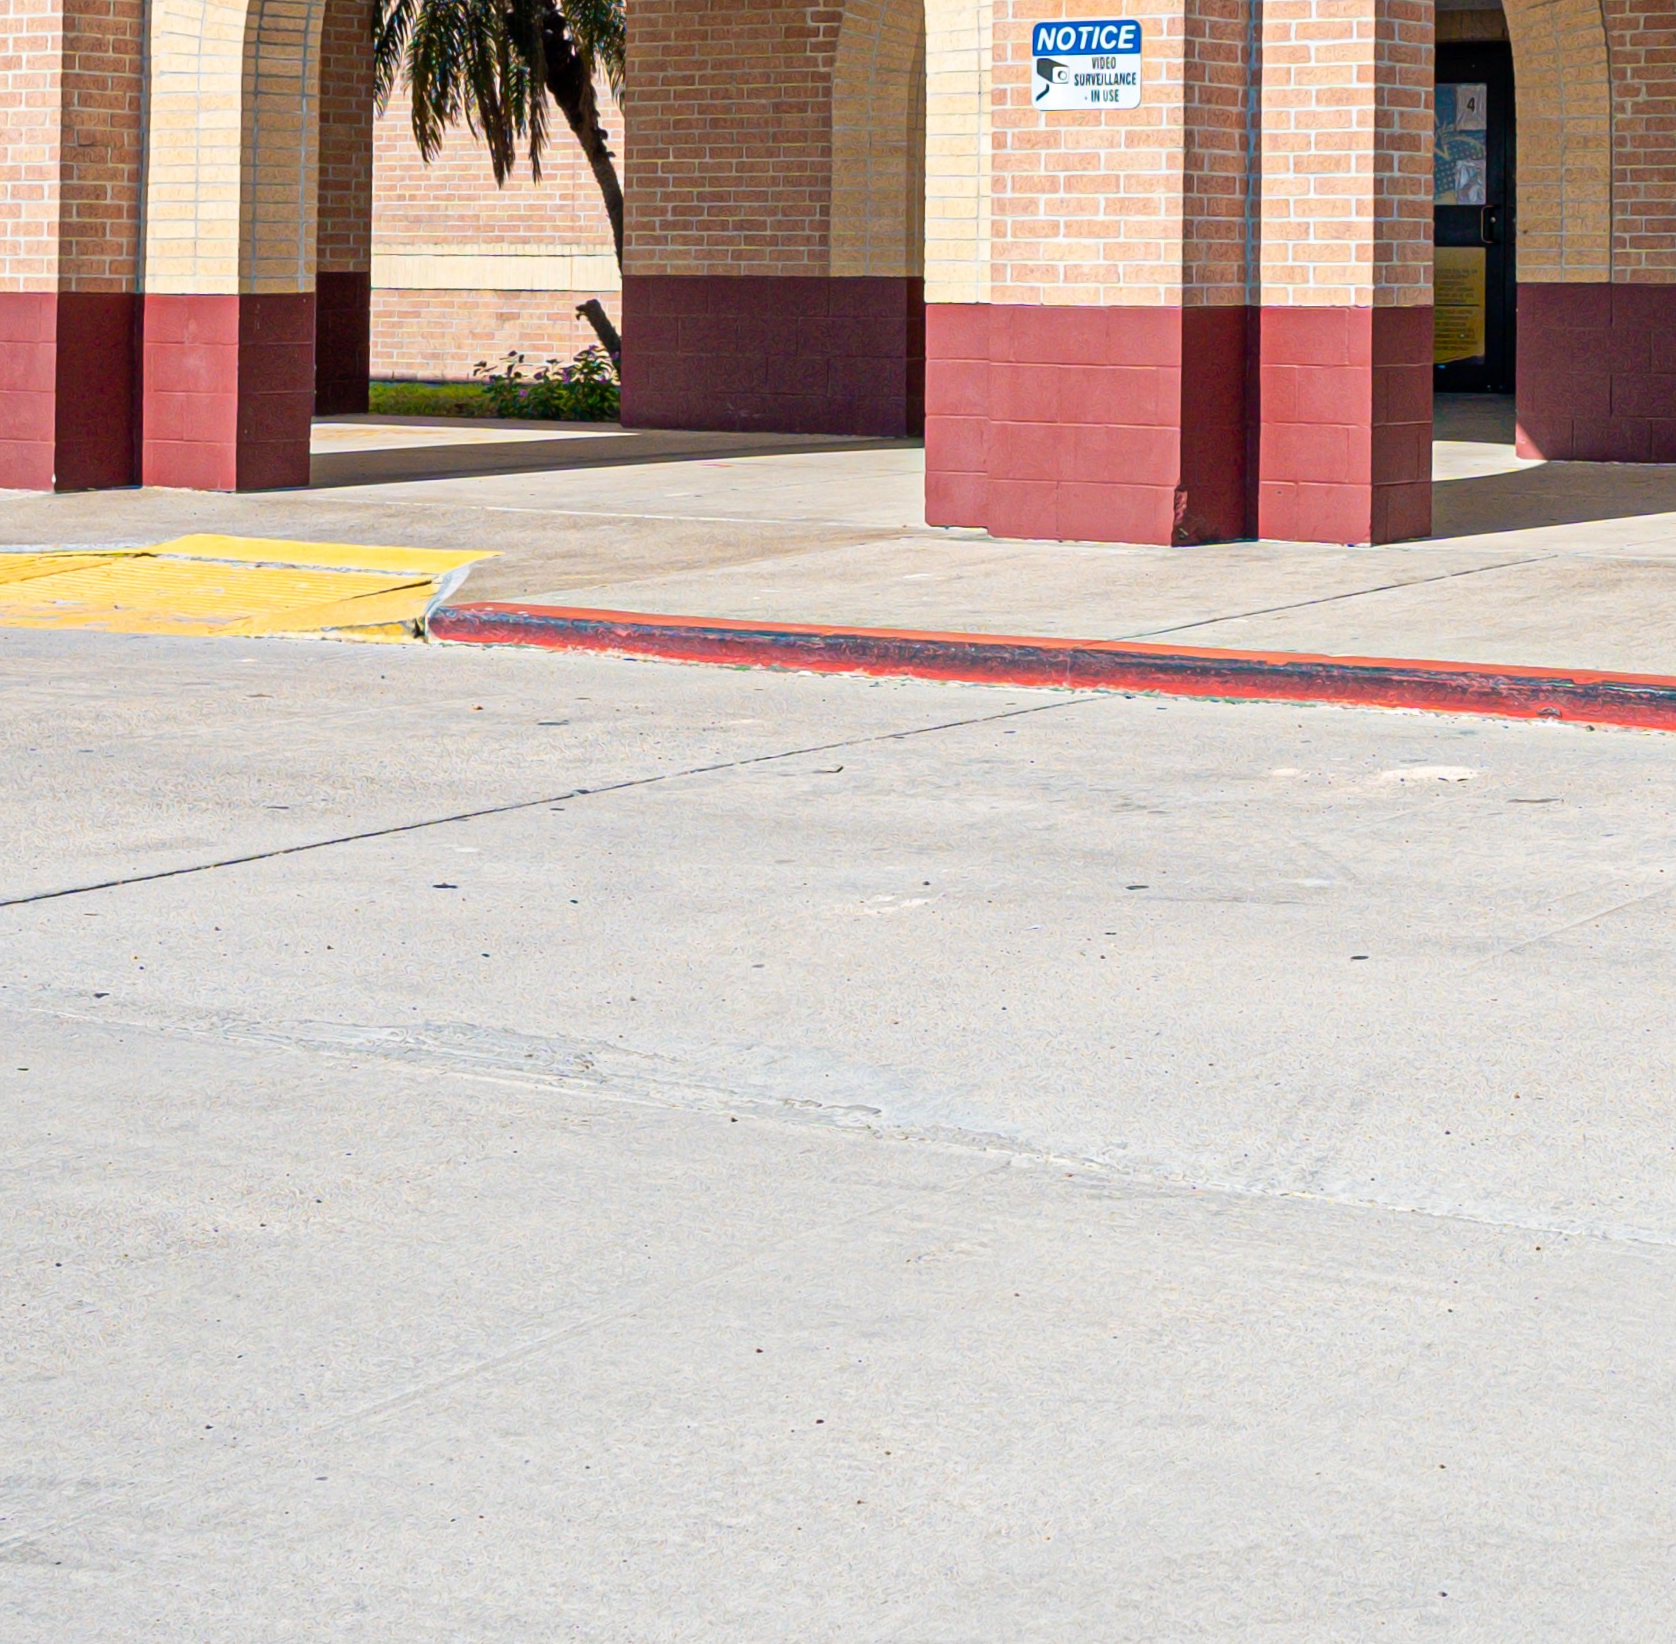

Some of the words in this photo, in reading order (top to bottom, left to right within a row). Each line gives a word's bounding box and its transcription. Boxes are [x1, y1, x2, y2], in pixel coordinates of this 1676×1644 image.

[1037, 24, 1136, 51] NOTICE
[1091, 56, 1116, 69] VIDEO
[1074, 72, 1136, 86] SURVEILLANCE
[1091, 89, 1100, 102] IN
[1103, 89, 1119, 102] USE
[1466, 96, 1476, 112] 4
